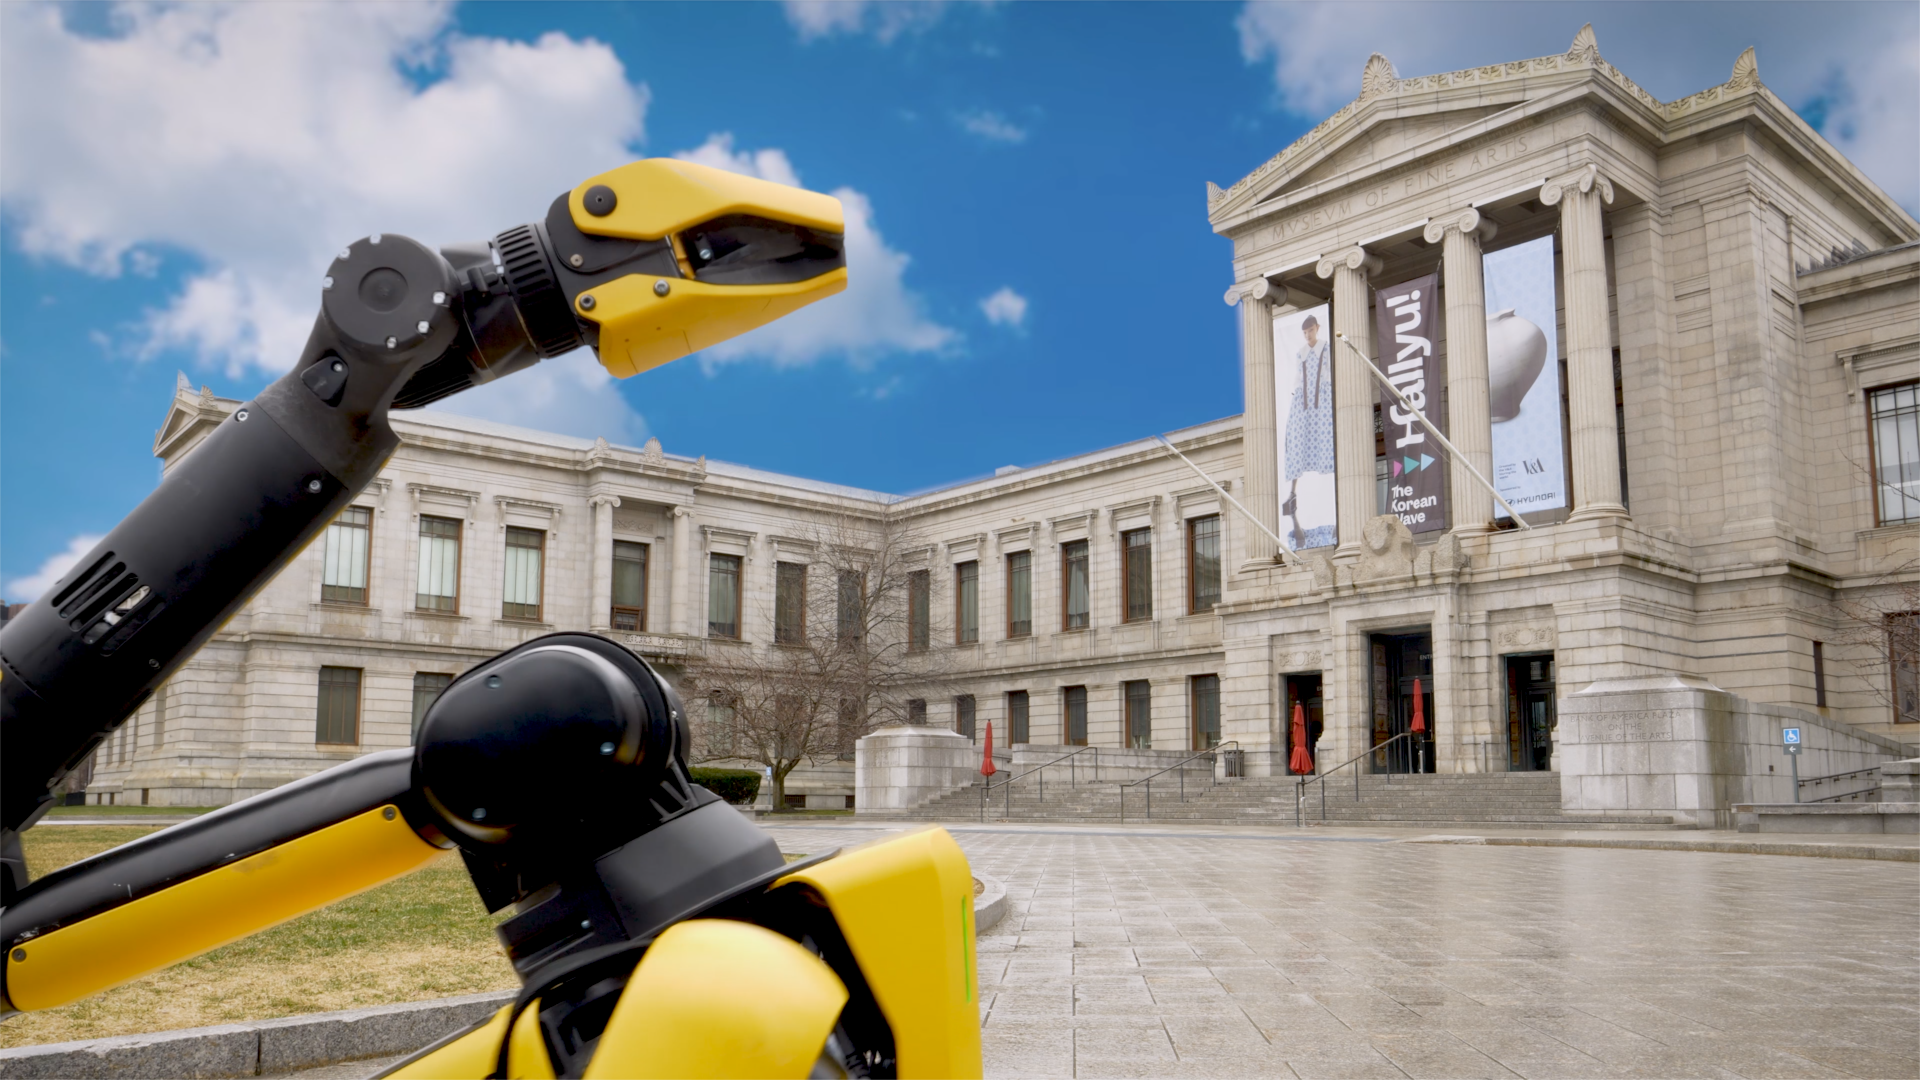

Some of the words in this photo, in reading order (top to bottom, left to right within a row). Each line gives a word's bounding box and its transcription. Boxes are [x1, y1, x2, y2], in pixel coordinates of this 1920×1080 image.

[1272, 201, 1351, 242] MVSEVM
[1365, 186, 1390, 208] OF
[1404, 163, 1456, 195] FINE
[1470, 136, 1528, 171] ARTS
[1386, 290, 1431, 449] Hallyu!
[1522, 458, 1545, 475] V&A
[1391, 484, 1413, 499] The
[1517, 492, 1556, 505] HYUNDAI
[1391, 495, 1437, 513] Korean
[1570, 715, 1594, 723] BANK
[1596, 714, 1608, 722] OF
[1611, 712, 1649, 721] AMERICA
[1652, 711, 1681, 719] PLAZA
[1608, 723, 1621, 731] ON
[1625, 722, 1642, 731] THE
[1580, 733, 1613, 742] AVENUE
[1615, 733, 1627, 741] OF
[1630, 732, 1647, 740] THE
[1649, 731, 1672, 740] ARTS
